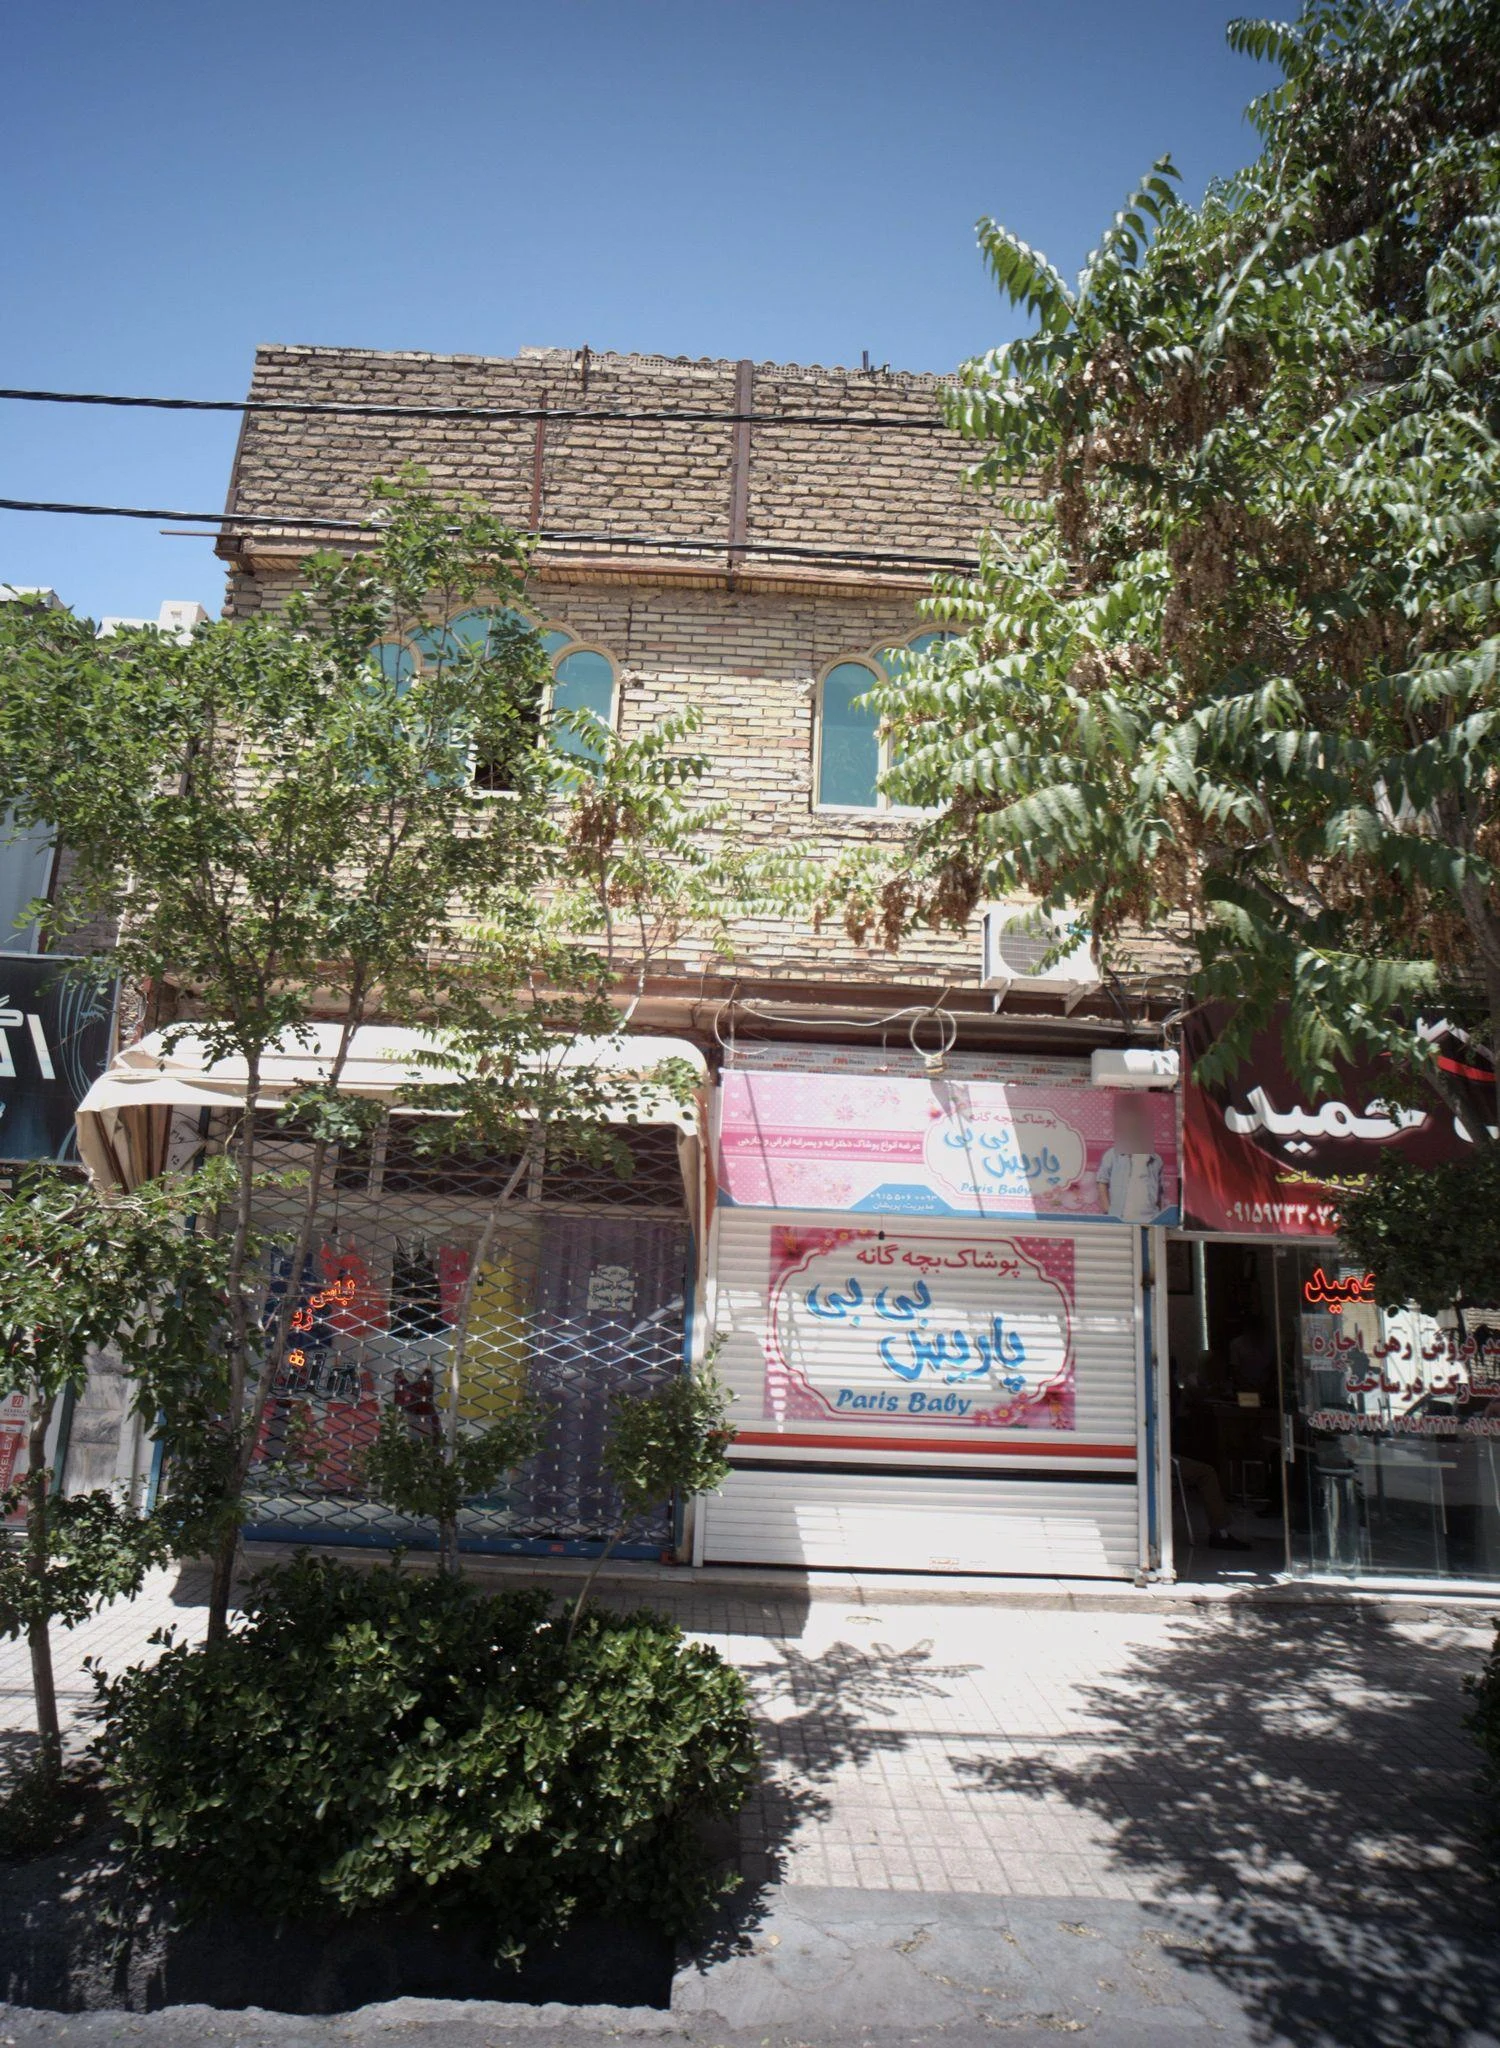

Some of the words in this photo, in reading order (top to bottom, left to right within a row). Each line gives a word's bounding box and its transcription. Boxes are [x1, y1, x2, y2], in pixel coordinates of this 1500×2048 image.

[969, 1111, 991, 1123] گانه
[1015, 1113, 1058, 1129] پوشاک
[1225, 1086, 1427, 1154] حمید
[983, 1147, 1061, 1184] پاریس
[1275, 1170, 1318, 1185] ساخت
[961, 1182, 993, 1194] Paris
[998, 1184, 1032, 1197] Baby
[856, 1243, 899, 1266] گانه
[902, 1252, 942, 1275] بچه
[943, 1249, 1020, 1278] پوشاک
[806, 1277, 864, 1327] بی
[874, 1279, 932, 1328] بی
[878, 1316, 1027, 1393] پاریس
[1314, 1329, 1365, 1360] اجاره
[1373, 1335, 1412, 1360] رهن
[1421, 1331, 1478, 1362] فروش
[1345, 1373, 1400, 1395] ساخت
[1401, 1376, 1424, 1402] در
[836, 1388, 899, 1409] Paris
[907, 1391, 973, 1416] Baby
